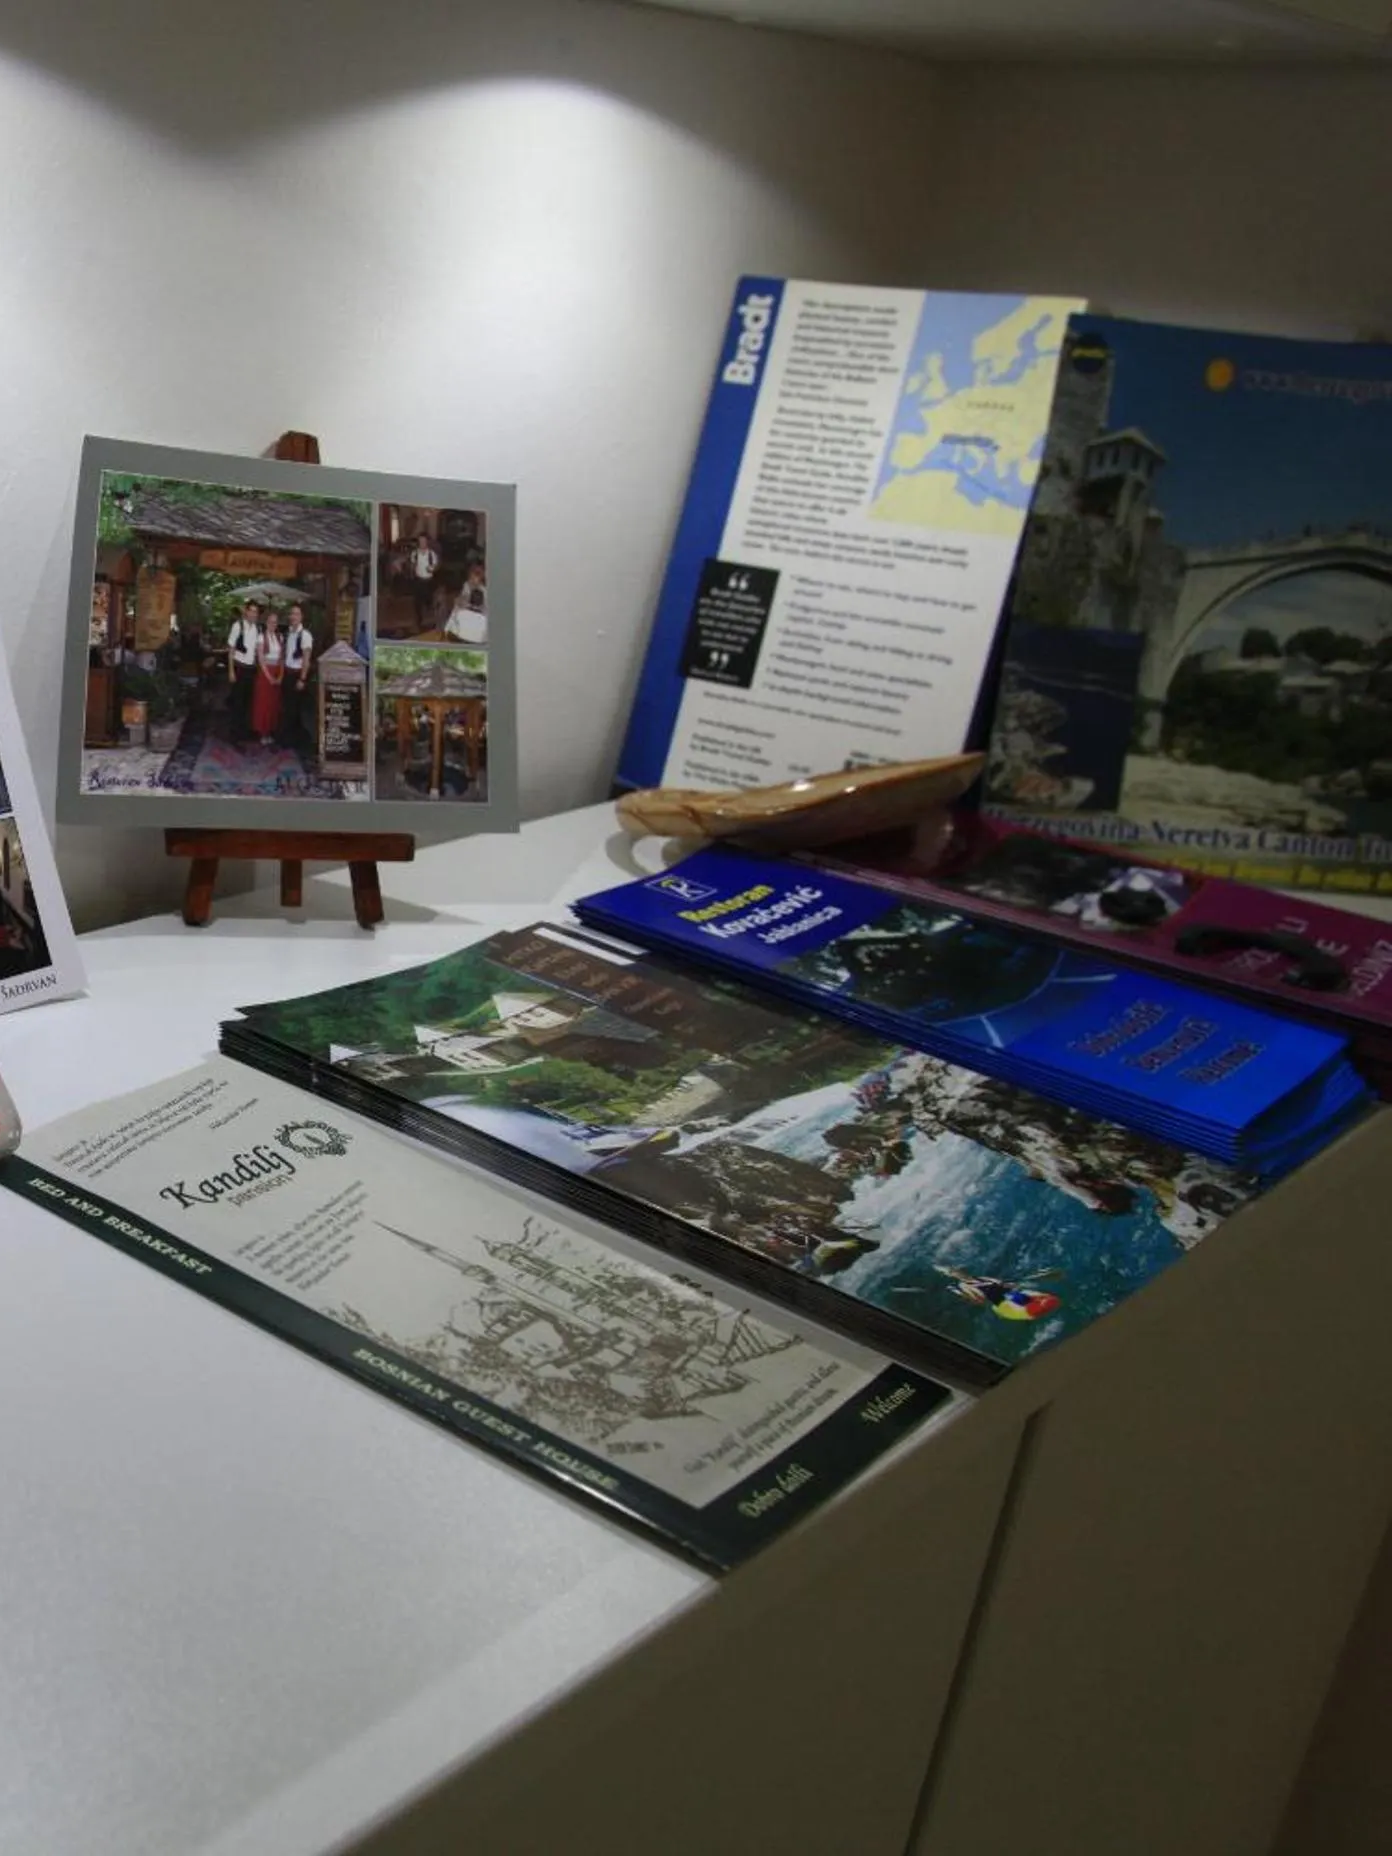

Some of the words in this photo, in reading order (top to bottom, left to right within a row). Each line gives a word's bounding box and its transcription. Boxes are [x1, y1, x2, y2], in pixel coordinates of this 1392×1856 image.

[722, 292, 775, 385] Bradt
[159, 1142, 297, 1210] Kandilj
[28, 1176, 64, 1198] BED
[61, 1195, 105, 1219] AND
[103, 1215, 213, 1276] BREAKFAST
[350, 1346, 448, 1406] BOSNIAN
[450, 1397, 532, 1445] GUEST
[532, 1438, 621, 1491] HOUSE
[859, 1381, 917, 1426] Welcome
